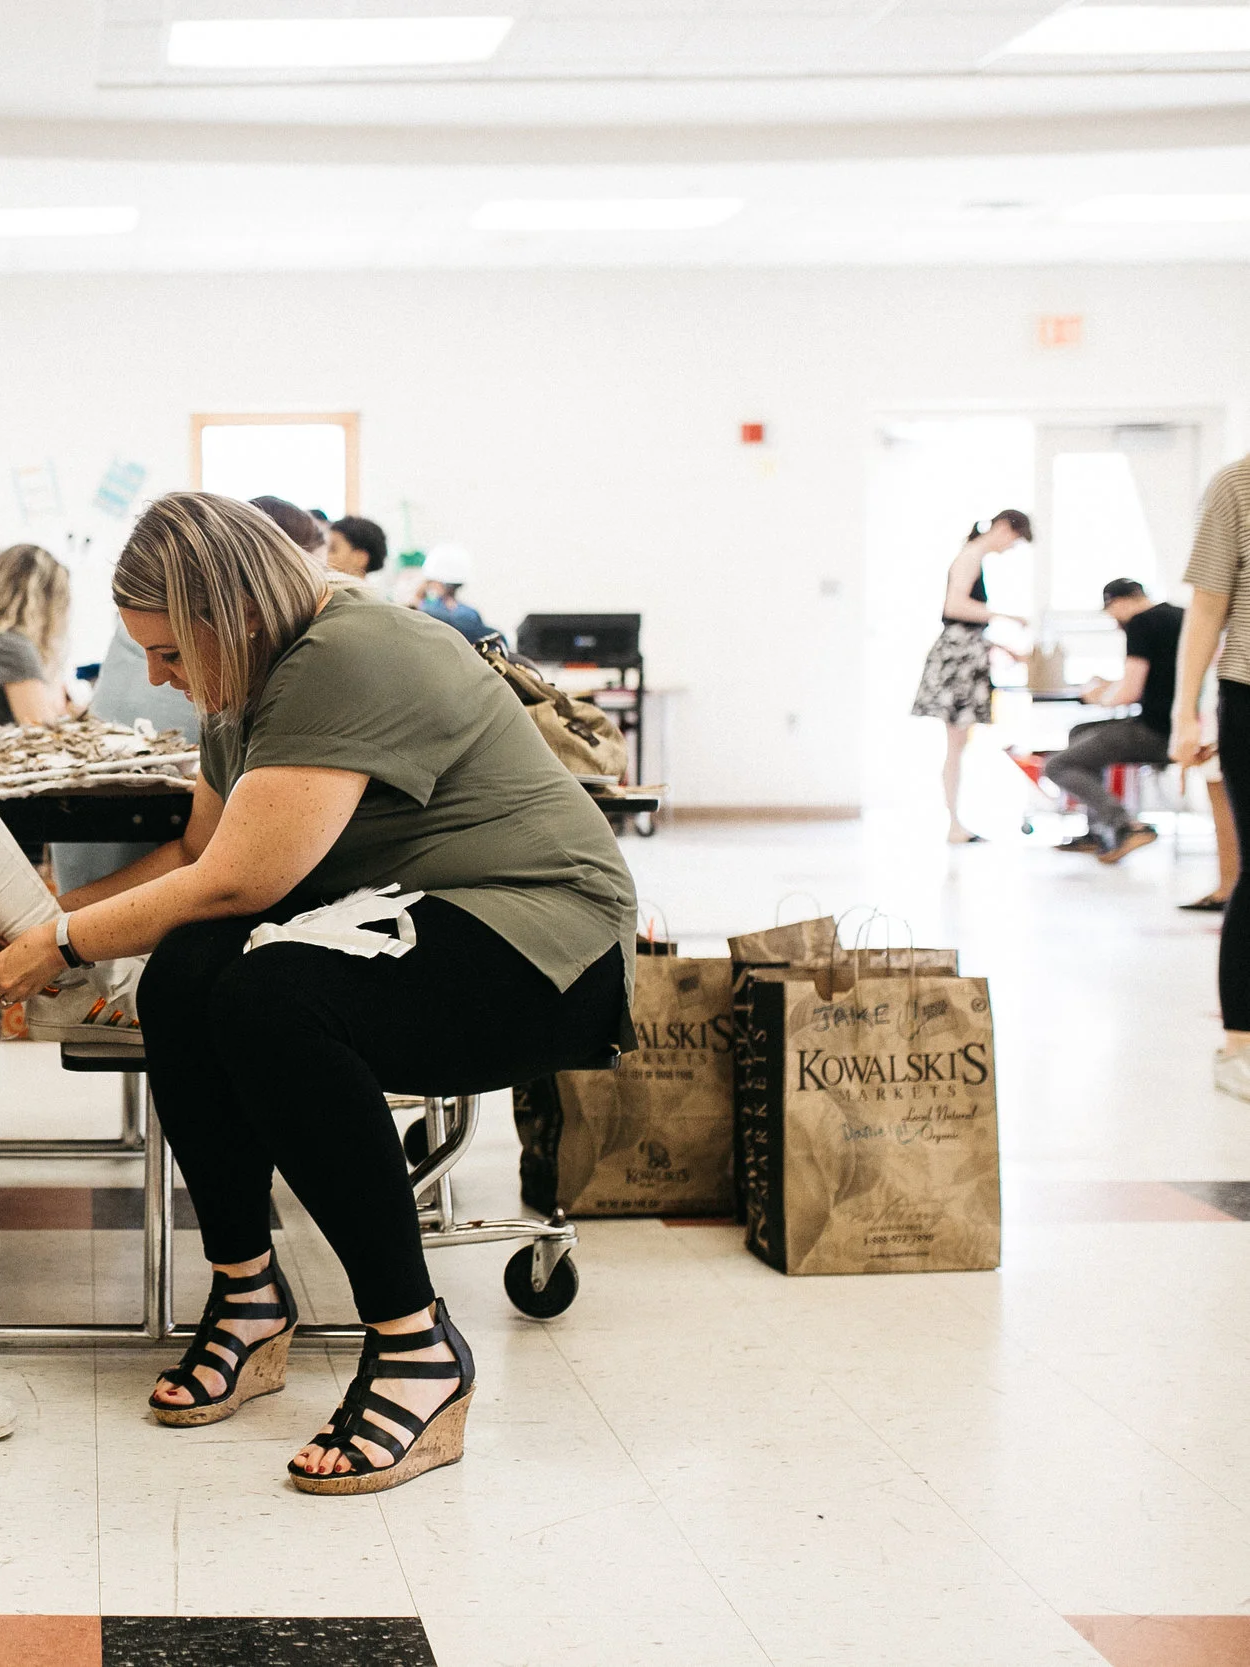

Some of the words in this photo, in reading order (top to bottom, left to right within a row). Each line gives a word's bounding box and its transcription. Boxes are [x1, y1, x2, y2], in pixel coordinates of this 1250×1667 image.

[813, 1003, 889, 1032] JAKE
[634, 1014, 732, 1053] ALSKI'S
[630, 1052, 707, 1065] ARKETS
[797, 1042, 989, 1091] KOWALSKI'S
[835, 1084, 956, 1101] MARKETS
